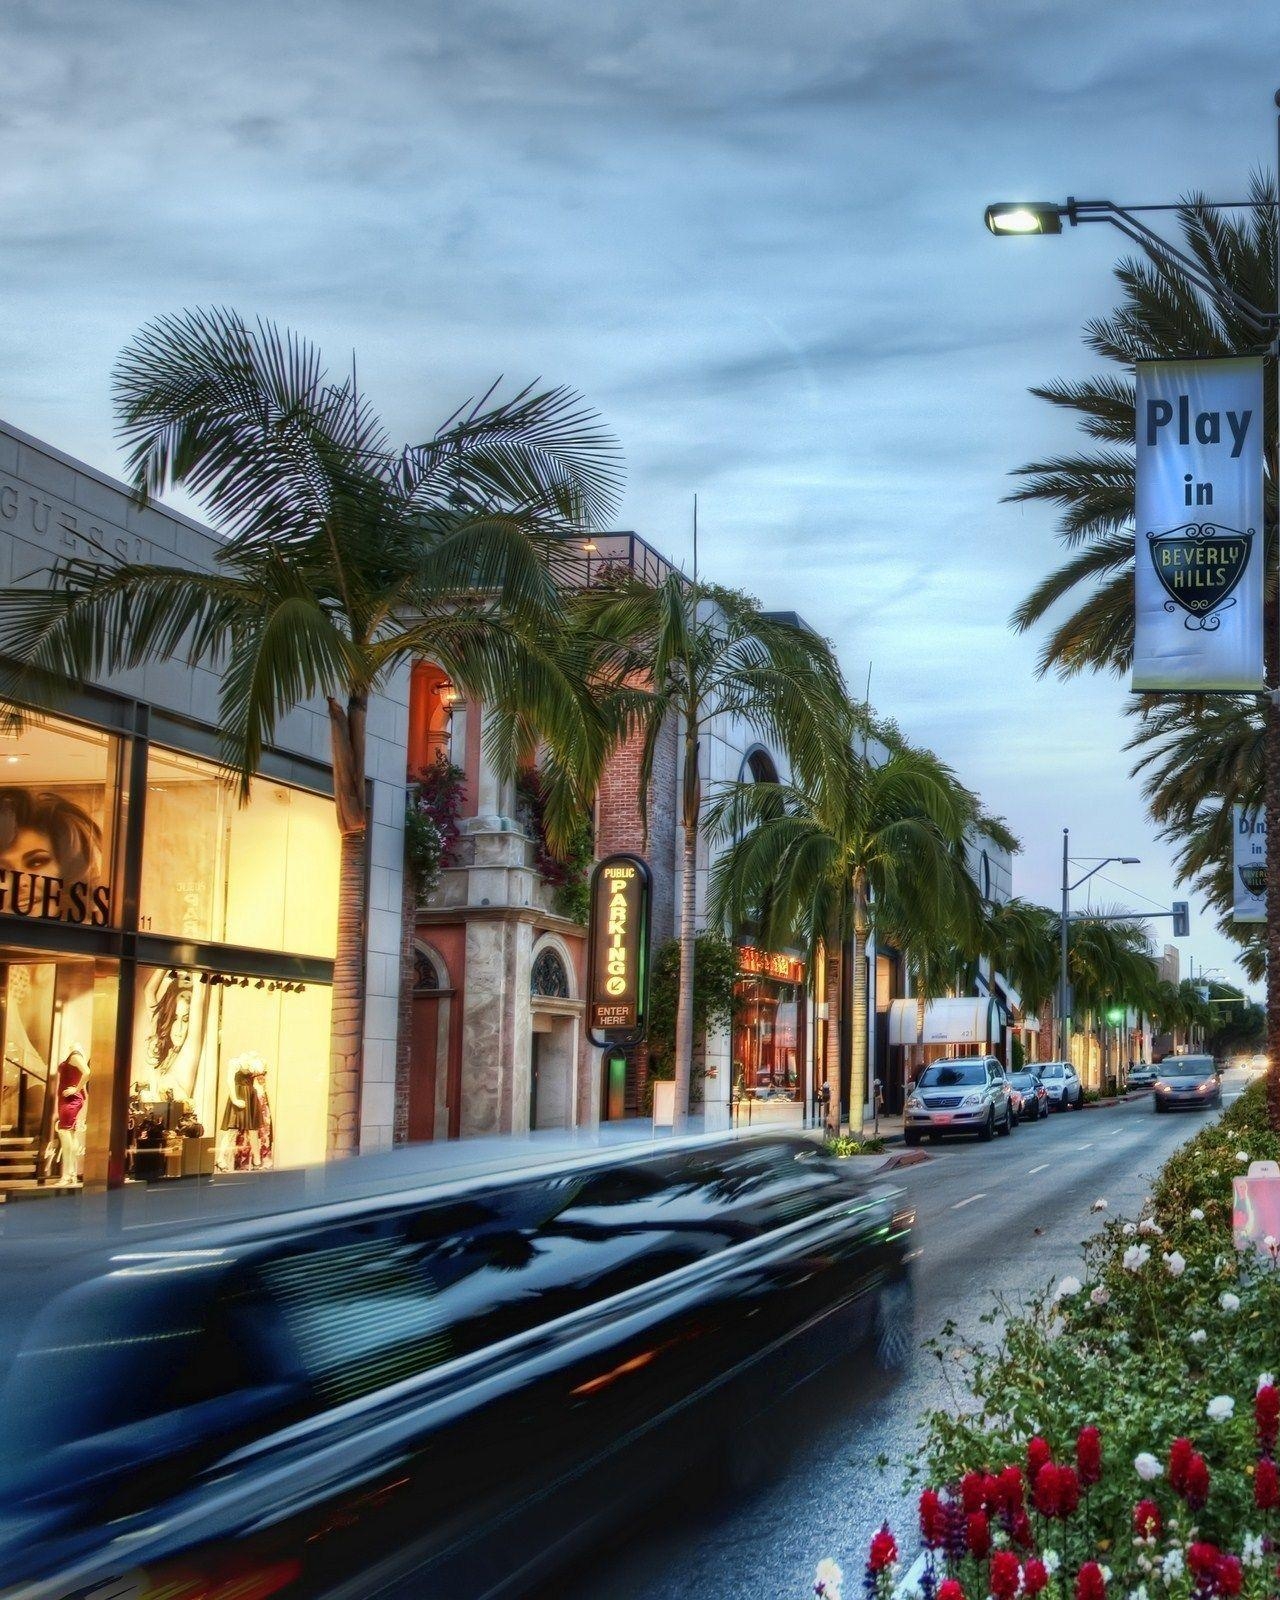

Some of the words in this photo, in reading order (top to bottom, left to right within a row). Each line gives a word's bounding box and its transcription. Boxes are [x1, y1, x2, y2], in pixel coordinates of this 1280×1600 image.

[1146, 394, 1253, 458] Play
[1183, 473, 1213, 506] in
[1162, 547, 1239, 567] BEVERLY
[1174, 567, 1226, 588] HILLS
[1251, 843, 1263, 854] in
[604, 868, 635, 879] PUBLIC
[608, 879, 628, 975] PARKING
[598, 1006, 629, 1016] ENTER
[601, 1016, 626, 1025] HERE
